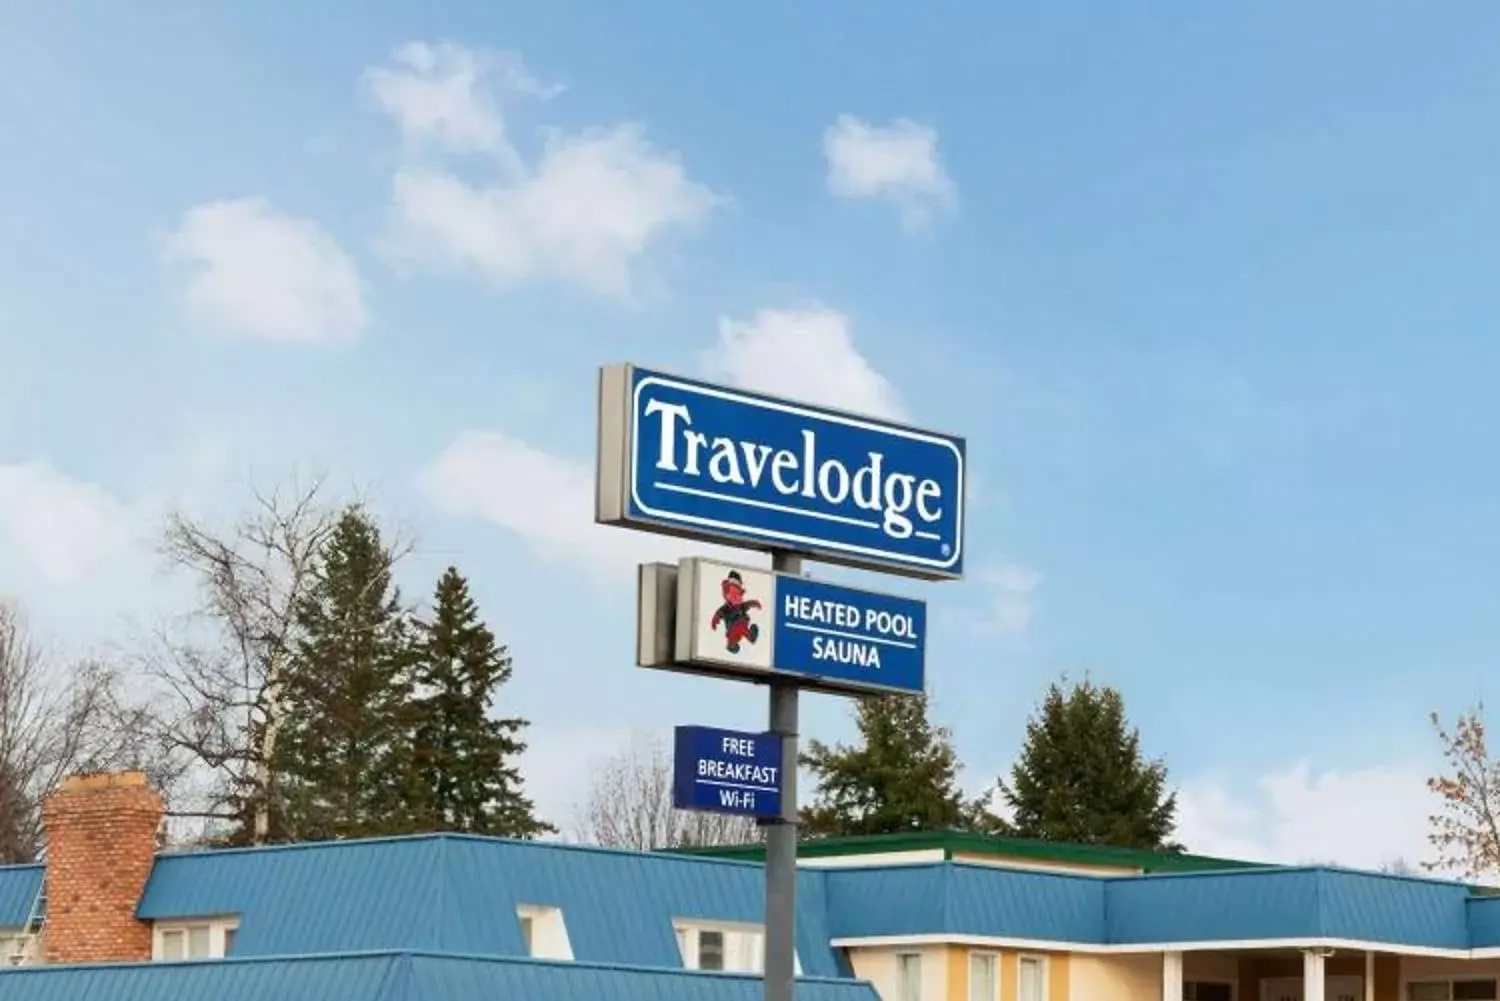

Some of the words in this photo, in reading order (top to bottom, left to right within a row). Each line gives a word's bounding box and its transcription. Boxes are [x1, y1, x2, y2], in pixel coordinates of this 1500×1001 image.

[645, 398, 942, 538] Travelodge
[785, 595, 860, 627] HEATED
[865, 609, 917, 638] POOL
[812, 637, 881, 669] SAUNA
[723, 737, 755, 757] FREE
[698, 758, 777, 783] BREAKFAST
[720, 790, 755, 809] Wi-Fi
